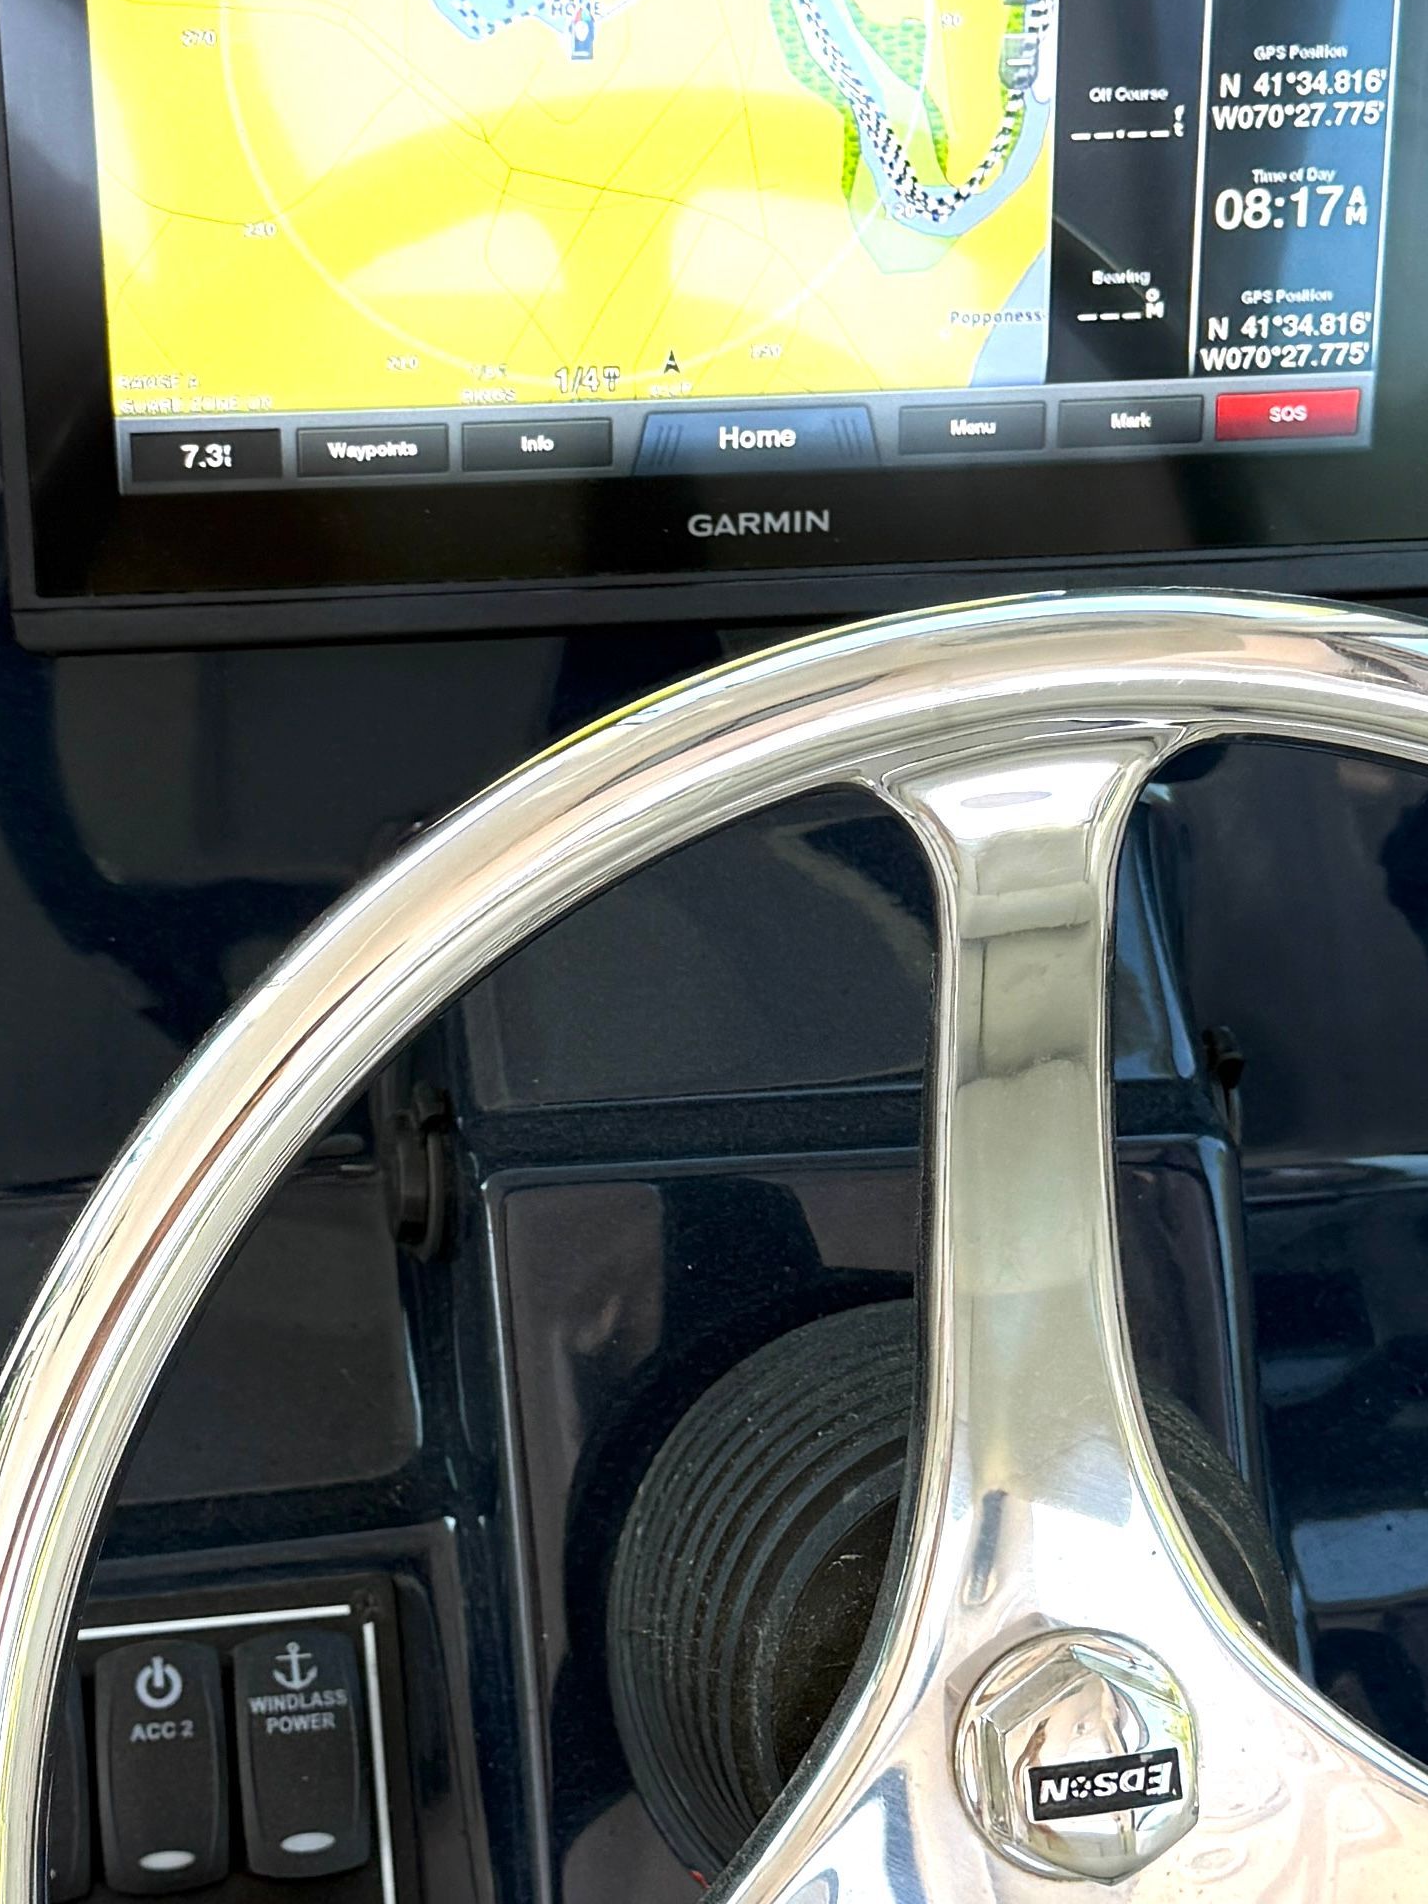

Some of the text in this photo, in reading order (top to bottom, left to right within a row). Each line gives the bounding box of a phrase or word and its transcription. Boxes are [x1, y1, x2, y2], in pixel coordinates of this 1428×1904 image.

[1252, 43, 1349, 63] GPS Position
[1114, 86, 1169, 103] Course
[1219, 72, 1242, 99] N
[1251, 166, 1337, 185] Time of Day
[1214, 184, 1345, 231] 08:17
[1091, 269, 1152, 287] Bearing
[1240, 288, 1334, 306] GPS Position
[1206, 317, 1230, 342] N
[553, 365, 603, 395] 1/4
[1110, 411, 1152, 430] Mark
[1268, 405, 1309, 424] SOS
[718, 425, 797, 450] Home
[950, 418, 998, 437] Menu
[326, 439, 418, 463] Waypoints
[520, 434, 555, 453] Info
[687, 508, 831, 538] GARMIN
[247, 1688, 349, 1715] WINDLASS
[129, 1719, 195, 1743] ACC 2
[264, 1711, 337, 1736] POWER
